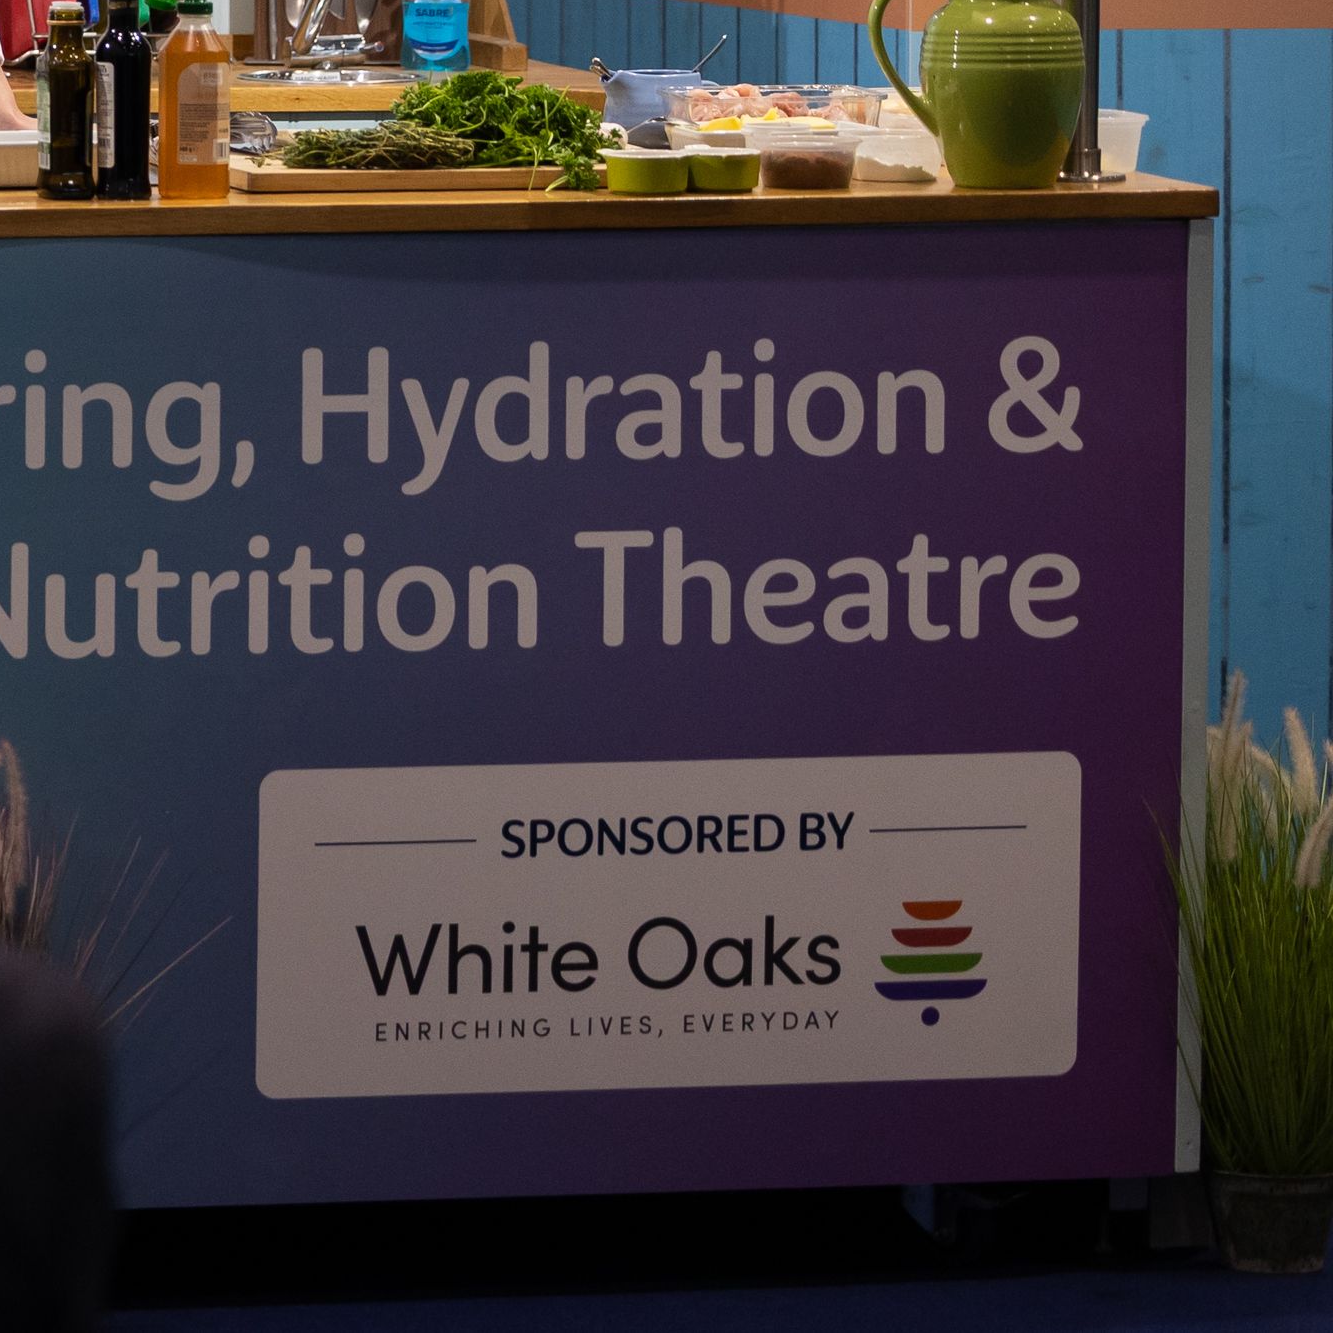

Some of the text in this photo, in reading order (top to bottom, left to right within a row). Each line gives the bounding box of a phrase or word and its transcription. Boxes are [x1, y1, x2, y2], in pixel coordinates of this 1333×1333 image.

[301, 337, 946, 496] Hydration
[988, 335, 1084, 454] &
[574, 526, 1081, 646] Theatre
[500, 811, 855, 859] SPONSORED BY
[355, 914, 842, 997] White Oaks
[375, 1009, 839, 1042] ENRICHING LIVES, EVERYDAY
